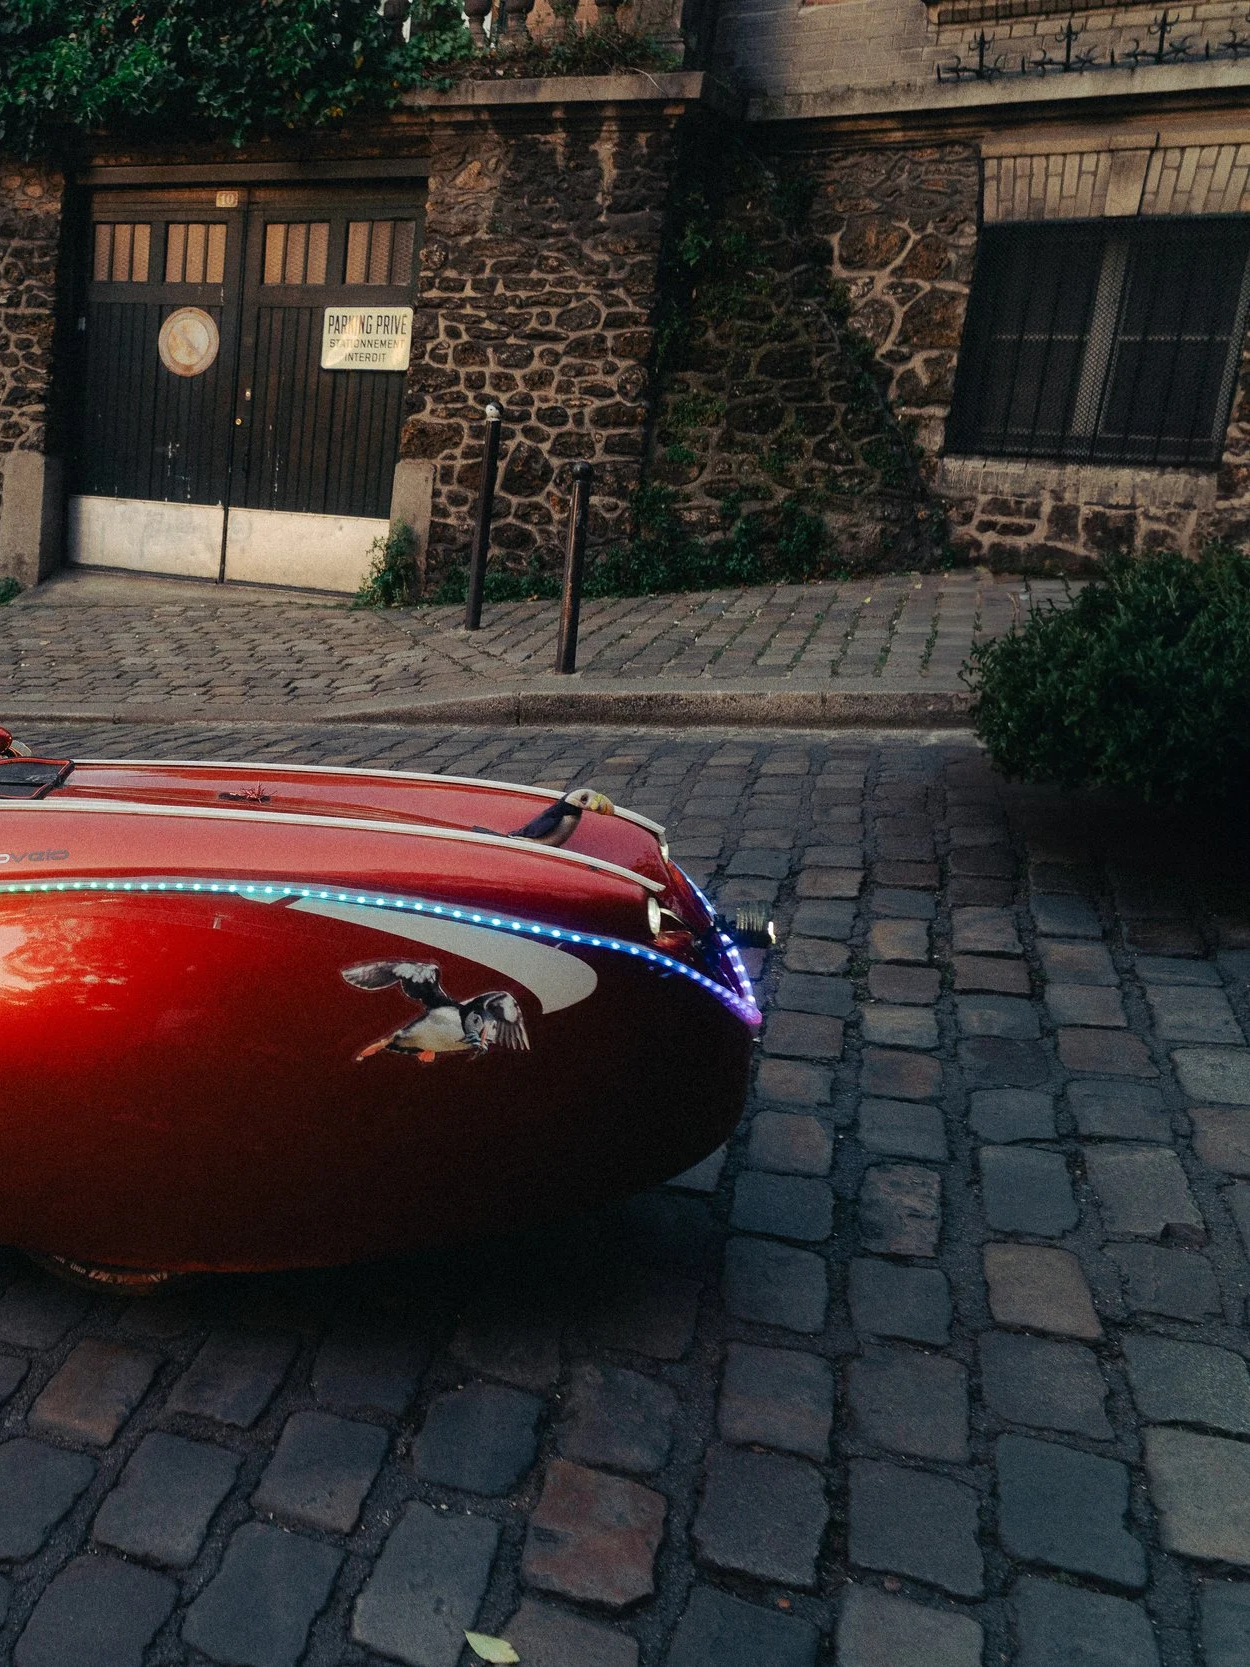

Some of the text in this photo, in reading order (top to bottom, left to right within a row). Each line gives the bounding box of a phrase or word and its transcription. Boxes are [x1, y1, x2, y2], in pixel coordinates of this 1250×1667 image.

[328, 315, 372, 334] PARKING
[329, 338, 405, 349] STATIONNEMENT
[344, 352, 386, 362] INTERDIT
